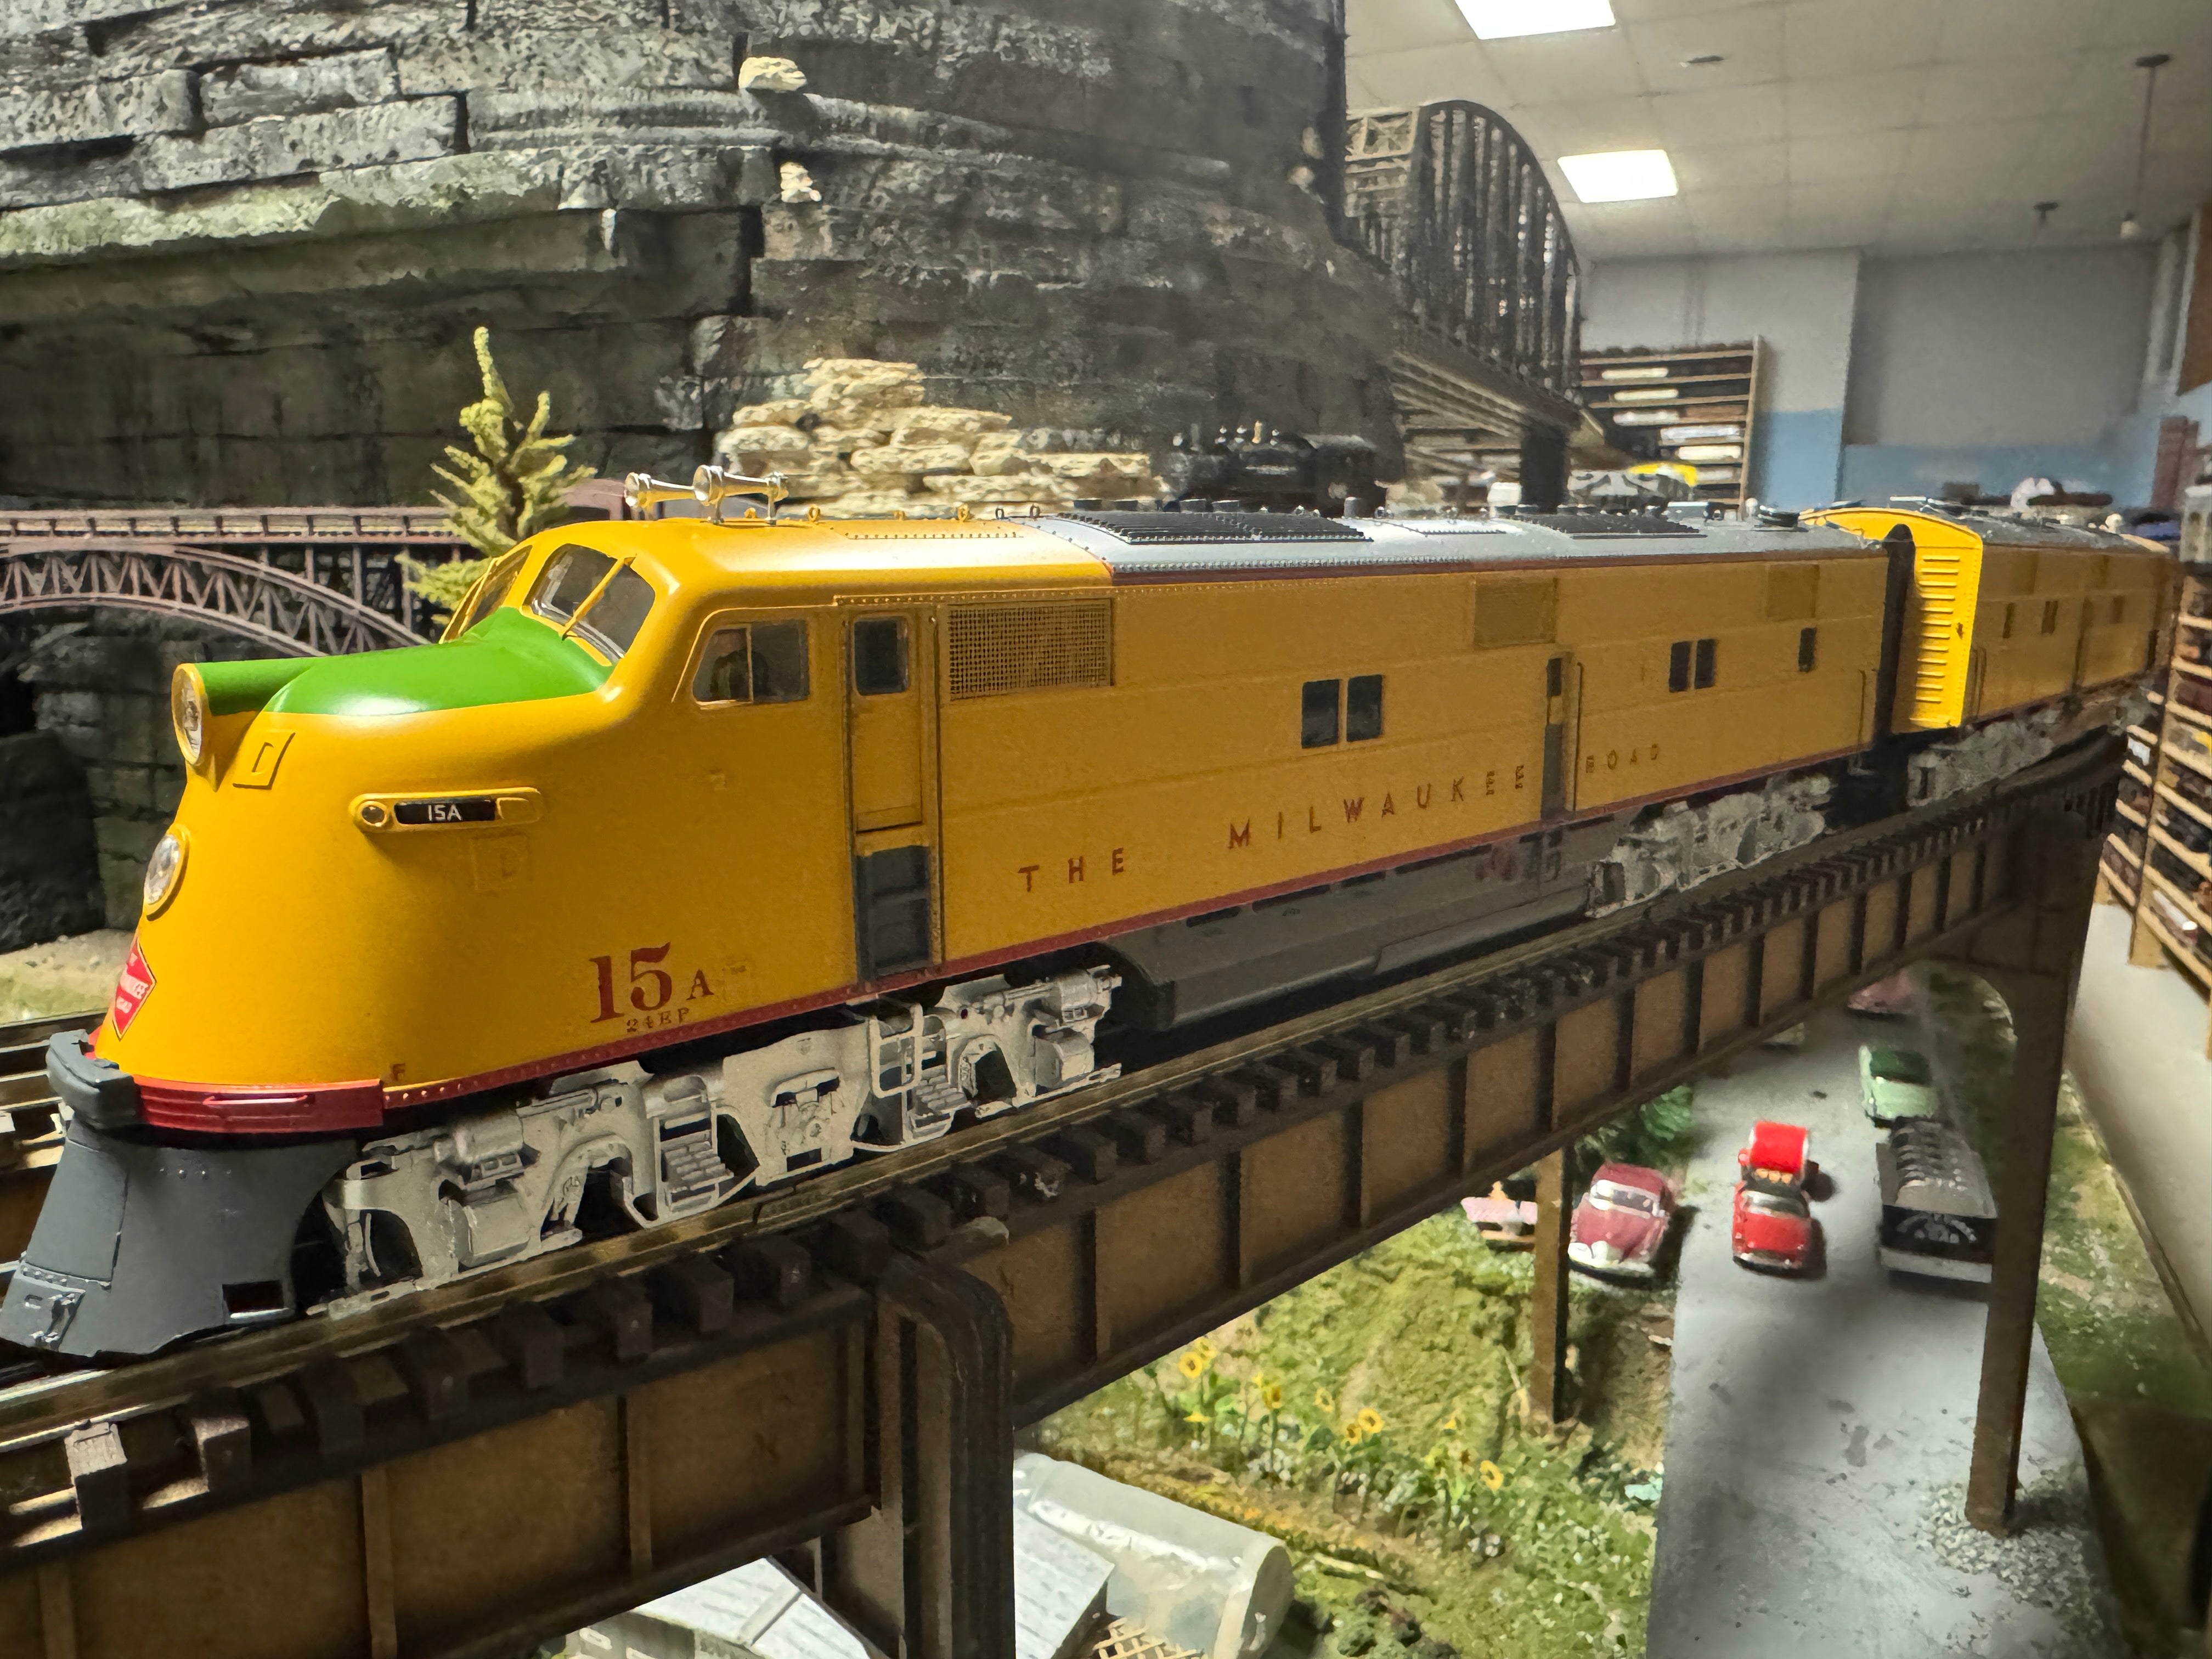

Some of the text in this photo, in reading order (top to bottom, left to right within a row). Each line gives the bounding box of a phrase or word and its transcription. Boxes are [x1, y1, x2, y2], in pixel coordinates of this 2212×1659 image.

[428, 804, 462, 821] 15A
[1018, 848, 1124, 892] THE
[1227, 764, 1524, 849] MILWAUKEE
